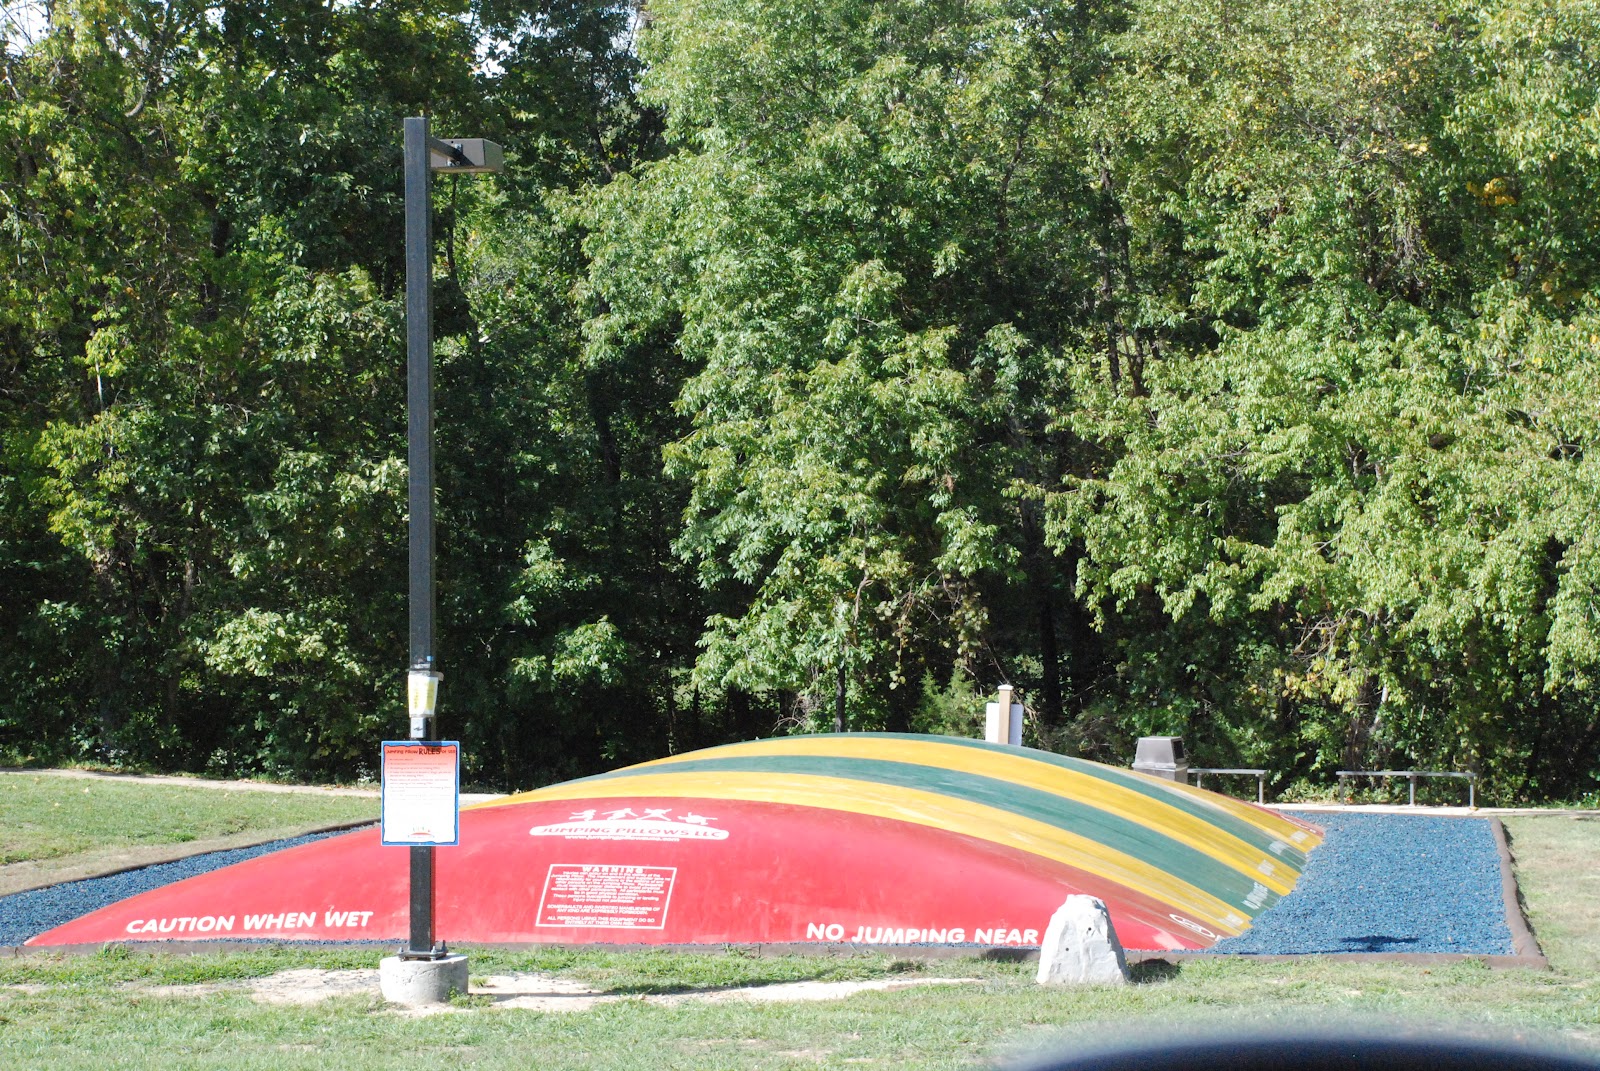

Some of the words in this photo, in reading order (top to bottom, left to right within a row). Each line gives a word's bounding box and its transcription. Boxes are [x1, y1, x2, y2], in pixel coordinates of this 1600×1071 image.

[616, 828, 689, 836] PILLOWS
[126, 915, 236, 934] CAUTION
[243, 912, 316, 930] WHEN
[324, 910, 374, 928] WET
[806, 922, 845, 940] NO
[851, 925, 965, 944] JUMPING
[974, 928, 1038, 944] NEAR
